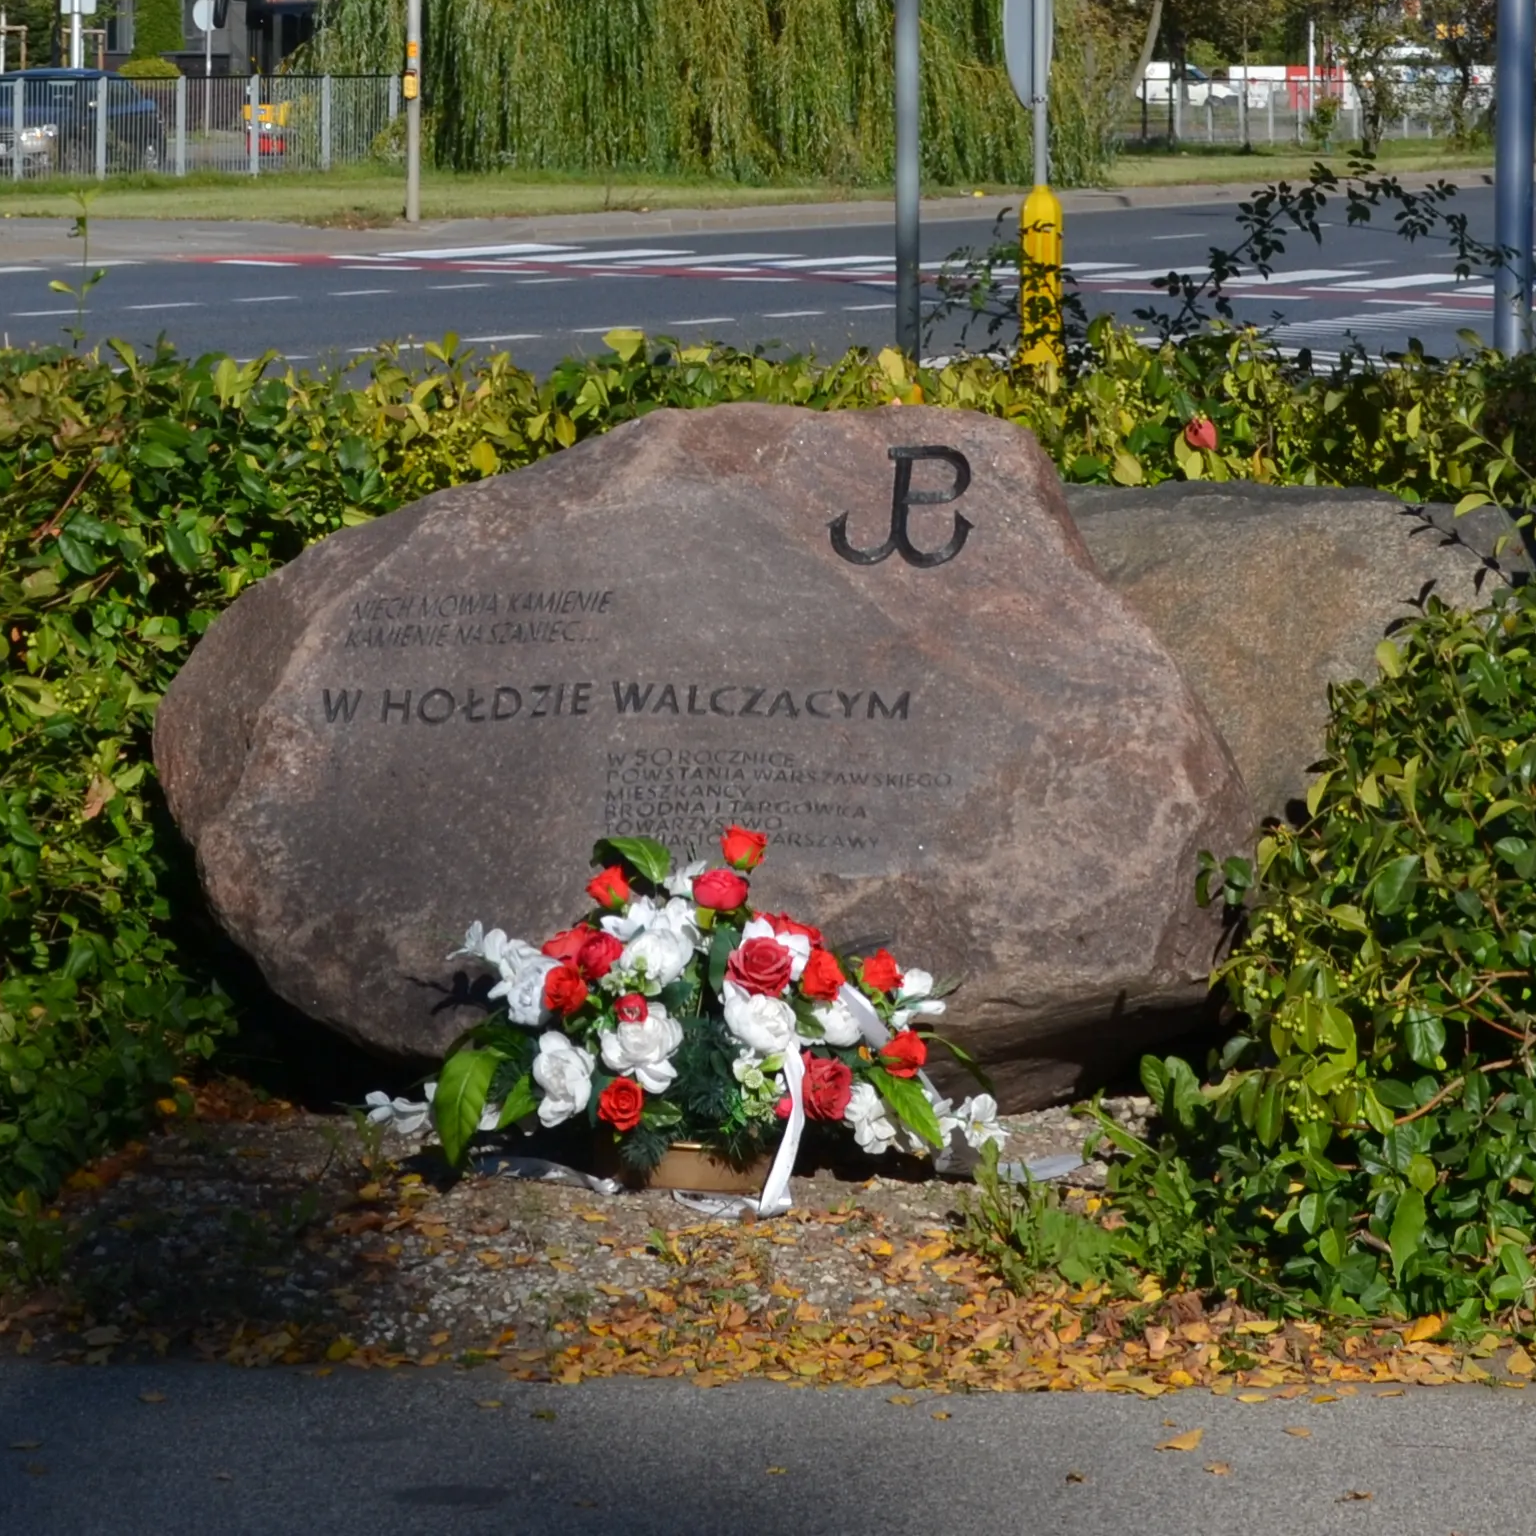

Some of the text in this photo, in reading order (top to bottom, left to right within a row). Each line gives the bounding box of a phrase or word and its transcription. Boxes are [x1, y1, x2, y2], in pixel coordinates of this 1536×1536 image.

[351, 595, 415, 621] NIECH
[508, 589, 614, 616] KAMIENIE
[344, 623, 451, 649] KAMIENIE
[454, 623, 483, 646] NA
[322, 687, 363, 724] W
[380, 682, 593, 726] HOŁDZIE
[606, 752, 627, 766] W
[635, 747, 674, 766] 50
[605, 765, 953, 789] POWSTANIA WARSZAWSKIEGO
[605, 816, 783, 837] TOWARZYSTWO
[766, 832, 880, 850] ARSZAWY
